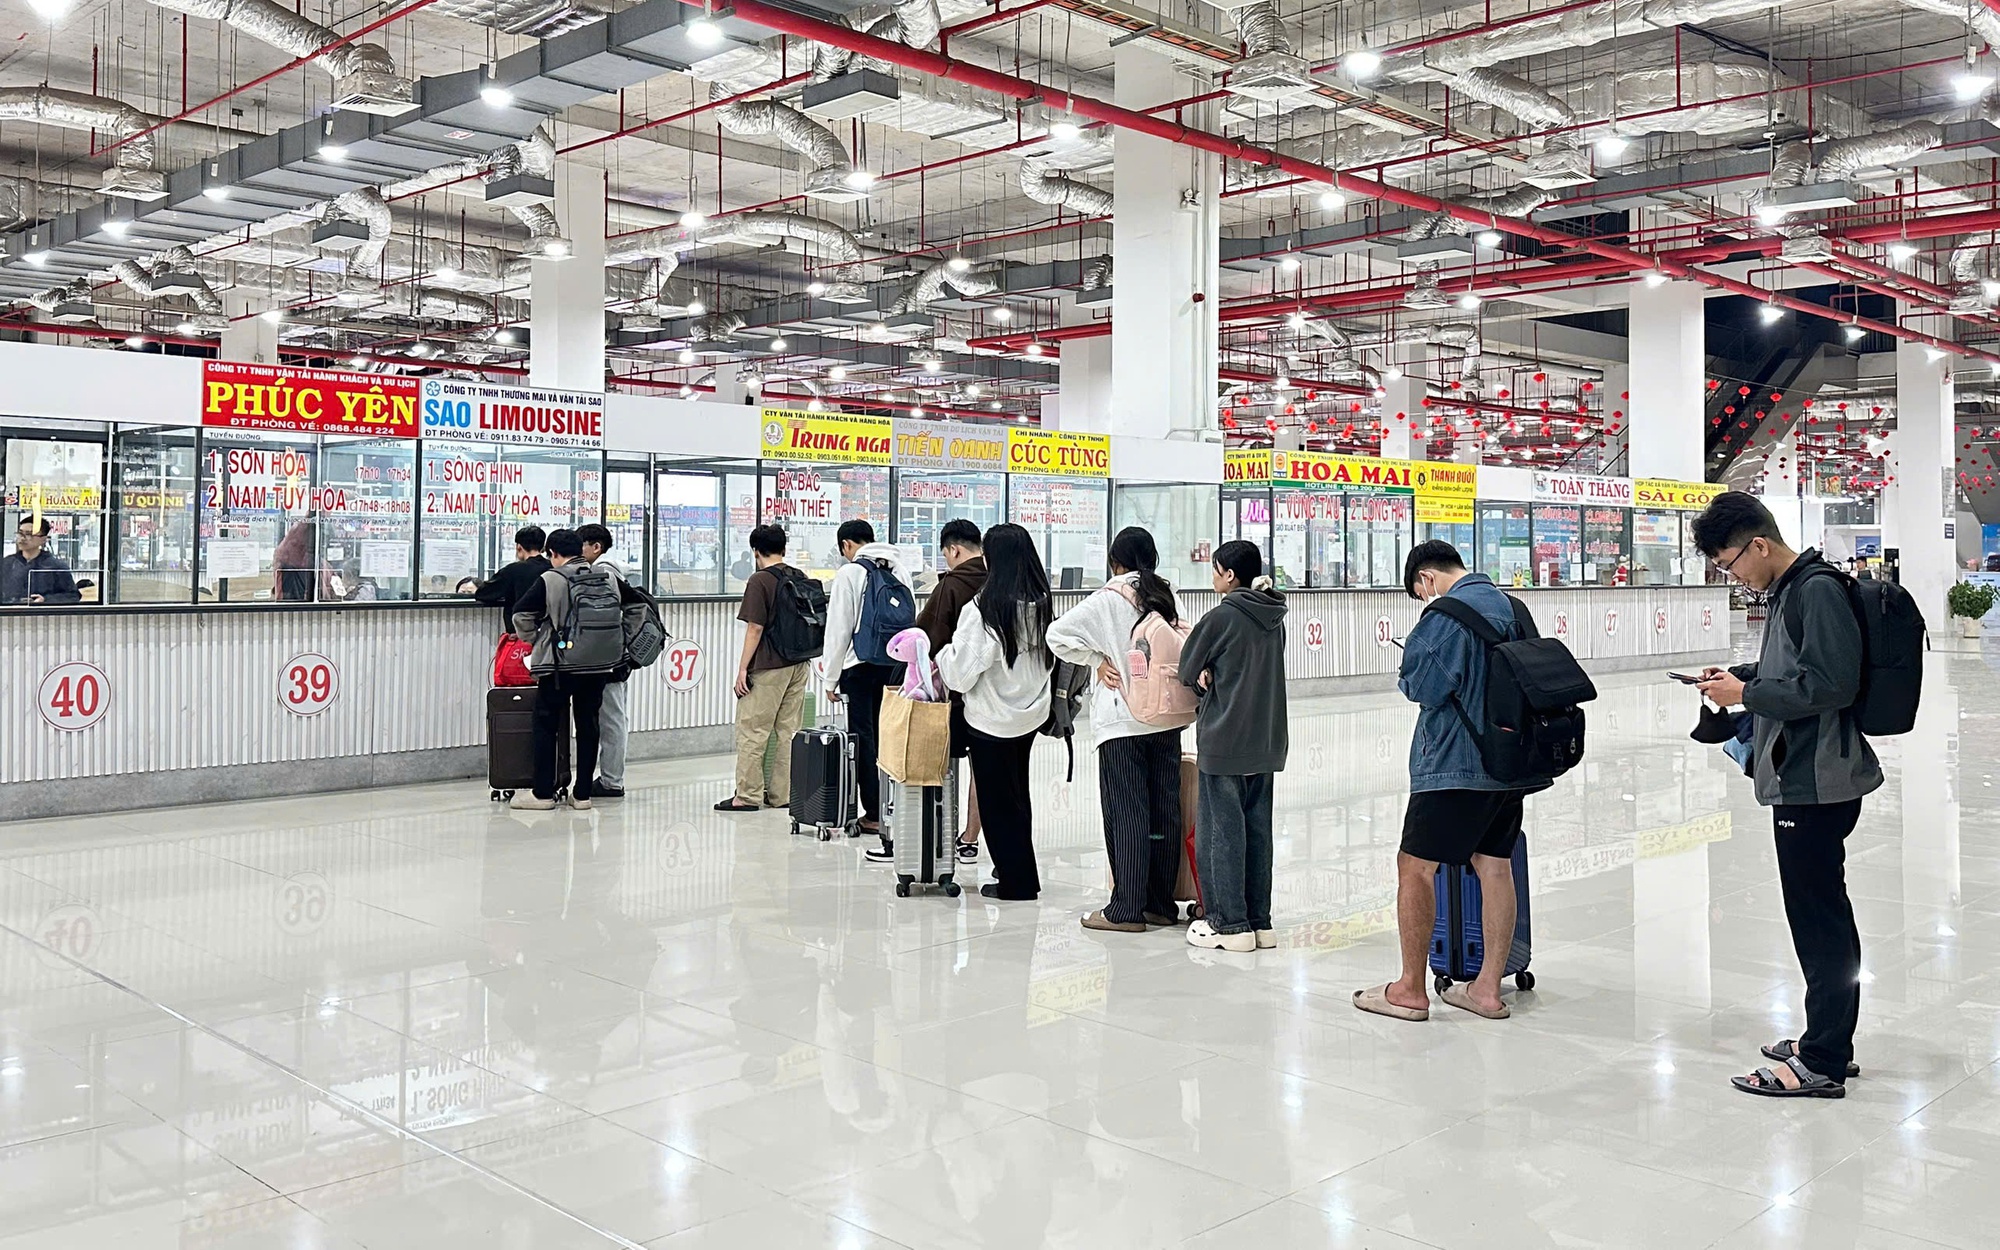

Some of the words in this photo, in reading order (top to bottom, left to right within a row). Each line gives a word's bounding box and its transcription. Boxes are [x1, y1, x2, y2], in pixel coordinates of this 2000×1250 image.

[208, 363, 234, 373] CÔNG
[237, 366, 248, 374] TY
[250, 367, 274, 376] TNHH
[297, 369, 310, 379] TẢI
[313, 370, 337, 381] HÀNH
[340, 372, 368, 384] KHÁCH
[370, 376, 382, 385] VÀ
[384, 378, 394, 386] DU
[398, 380, 416, 388] LỊCH
[206, 377, 323, 419] PHÚC
[336, 385, 416, 425] YÊN
[444, 384, 465, 395] CÔNG
[468, 388, 476, 396] TY
[479, 388, 499, 398] TNHH
[501, 390, 530, 400] THƯƠNG
[532, 392, 546, 403] MẠI
[548, 393, 557, 402] VÀ
[560, 395, 573, 405] VẬN
[576, 395, 586, 405] TẢI
[589, 397, 601, 406] SAO
[231, 417, 247, 426] ĐT
[252, 418, 296, 430] PHÒNG
[323, 424, 372, 433] 0868.484
[375, 427, 394, 435] 224
[424, 398, 470, 428] SAO
[480, 403, 601, 436] LIMOUSINE
[425, 429, 437, 437] ĐT
[440, 429, 471, 439] PHÒNG
[491, 433, 521, 442] 0911.83
[551, 437, 578, 445] 0905.71
[789, 422, 850, 451] TRUNG
[856, 437, 890, 453] NGA
[897, 431, 944, 457] TIẾN
[950, 439, 1004, 461] OANH
[1029, 431, 1052, 439] NHÁNH
[209, 450, 223, 473] 1.
[228, 449, 264, 474] SƠN
[271, 446, 307, 476] HÒA
[912, 457, 943, 467] PHÒNG
[1011, 440, 1049, 465] CÚC
[1058, 442, 1108, 468] TÙNG
[355, 467, 380, 481] 17h10
[387, 468, 411, 481] 17h34
[428, 460, 439, 481] 1.
[444, 455, 485, 483] SÔNG
[490, 463, 523, 484] HINH
[578, 470, 598, 482] 18h15
[1247, 461, 1268, 479] MAI
[1291, 461, 1352, 482] HOA
[1361, 466, 1411, 486] MAI
[208, 486, 222, 508] 2.
[228, 486, 266, 509] NAM
[273, 486, 306, 510] TUY
[311, 483, 346, 511] HÒA
[550, 490, 571, 500] 18h22
[577, 490, 598, 501] 18h26
[1550, 476, 1584, 495] TOÀN
[1588, 479, 1630, 498] THẮNG
[1638, 489, 1675, 502] SÀI
[1683, 492, 1715, 504] GÒ
[427, 492, 439, 513] 2.
[444, 493, 475, 514] NAM
[480, 494, 506, 515] TUY
[511, 489, 540, 516] HÒA
[550, 506, 571, 516] 18h54
[578, 506, 598, 517] 19h05
[766, 497, 796, 516] PHAN
[800, 492, 832, 517] THIẾT
[1362, 497, 1388, 521] LONG
[1021, 512, 1037, 523] NHA
[1041, 512, 1067, 524] TRANG
[1557, 615, 1567, 634] 28
[1607, 613, 1617, 631] 27
[1657, 611, 1666, 629] 26
[1703, 609, 1712, 626] 25
[1308, 623, 1322, 645] 32
[1378, 621, 1390, 642] 31
[511, 648, 528, 659] Sk
[670, 650, 698, 682] 37
[288, 664, 331, 704] 39
[51, 674, 99, 717] 40
[1778, 820, 1795, 828] style
